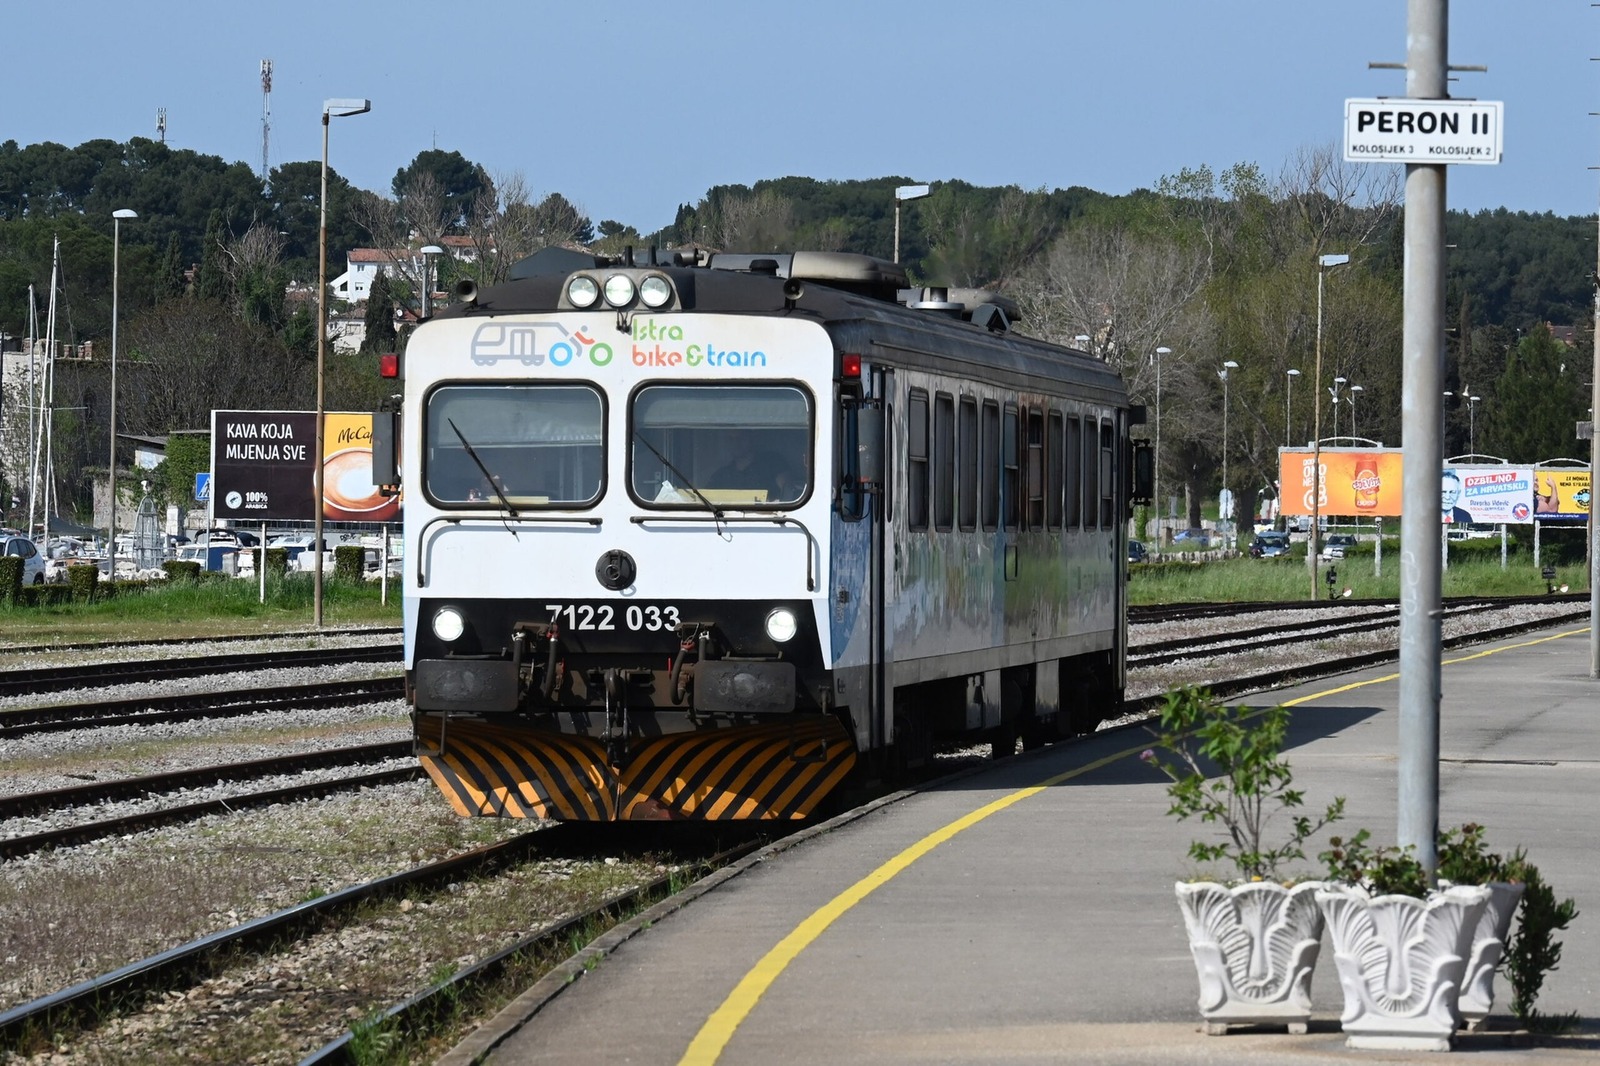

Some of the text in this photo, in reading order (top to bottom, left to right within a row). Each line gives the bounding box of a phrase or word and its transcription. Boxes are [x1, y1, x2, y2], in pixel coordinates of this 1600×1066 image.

[1358, 110, 1488, 135] PERON II
[1352, 144, 1491, 155] KOLOSIJEK 3 KOLOSIJEK 2
[632, 318, 683, 341] Istra
[226, 423, 293, 439] KAVA KOJA
[337, 426, 372, 444] McCa
[226, 444, 306, 461] MIJENJA SVE
[245, 492, 268, 502] 100%
[1466, 482, 1527, 496] ZA HRVATSKU.
[545, 605, 681, 632] 7122 033
